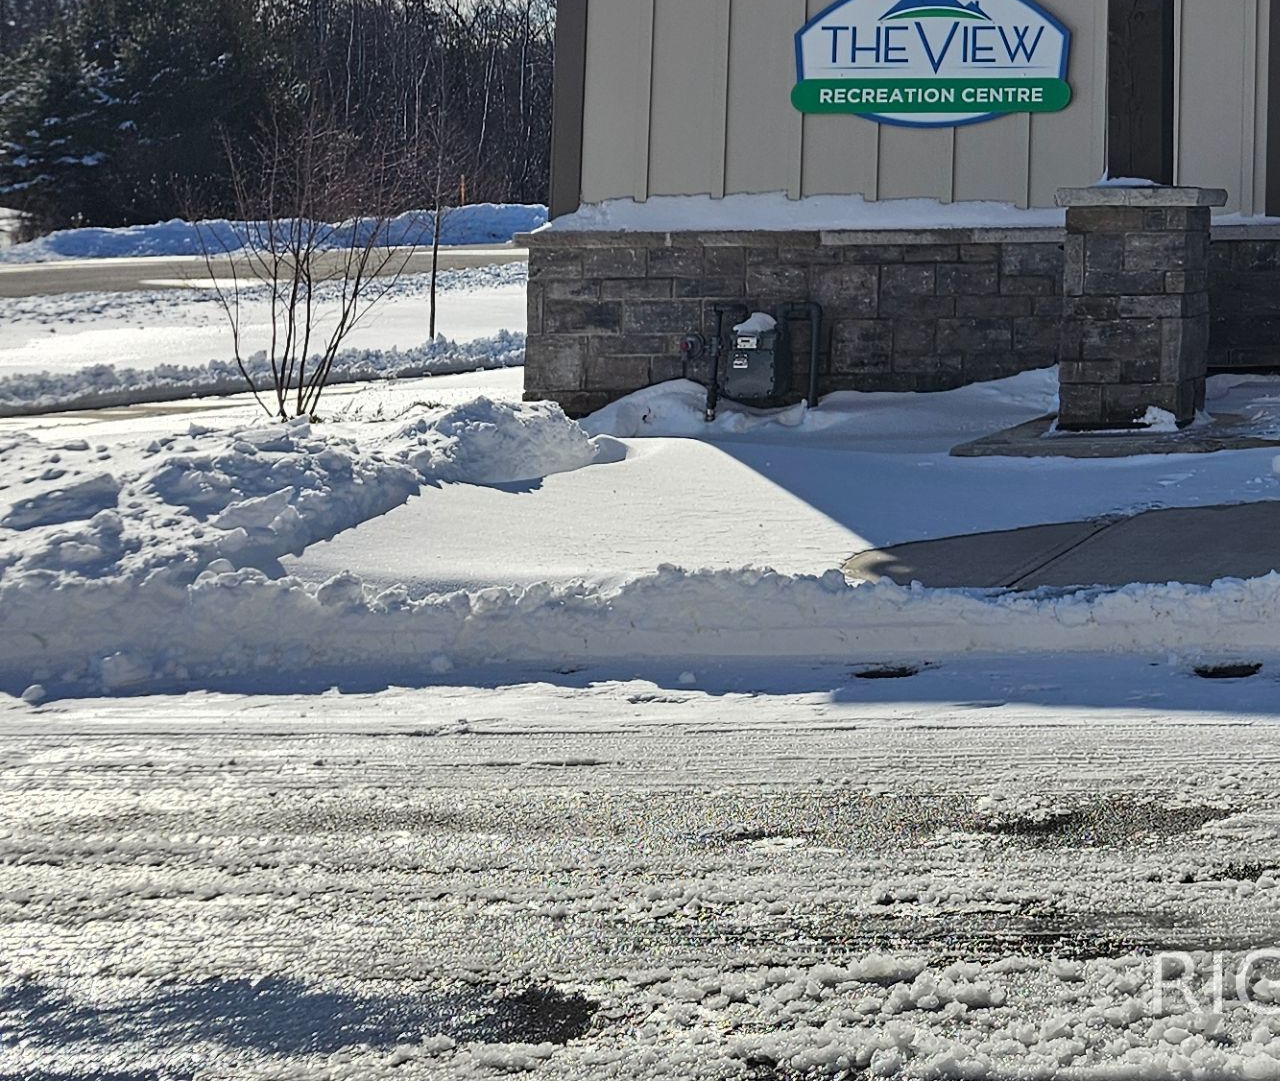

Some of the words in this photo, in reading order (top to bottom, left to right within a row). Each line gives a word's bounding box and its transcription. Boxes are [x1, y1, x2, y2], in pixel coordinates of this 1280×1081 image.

[821, 25, 909, 64] THE
[914, 21, 1045, 75] VIEW
[819, 88, 955, 104] RECREATION
[961, 87, 1044, 103] CENTRE
